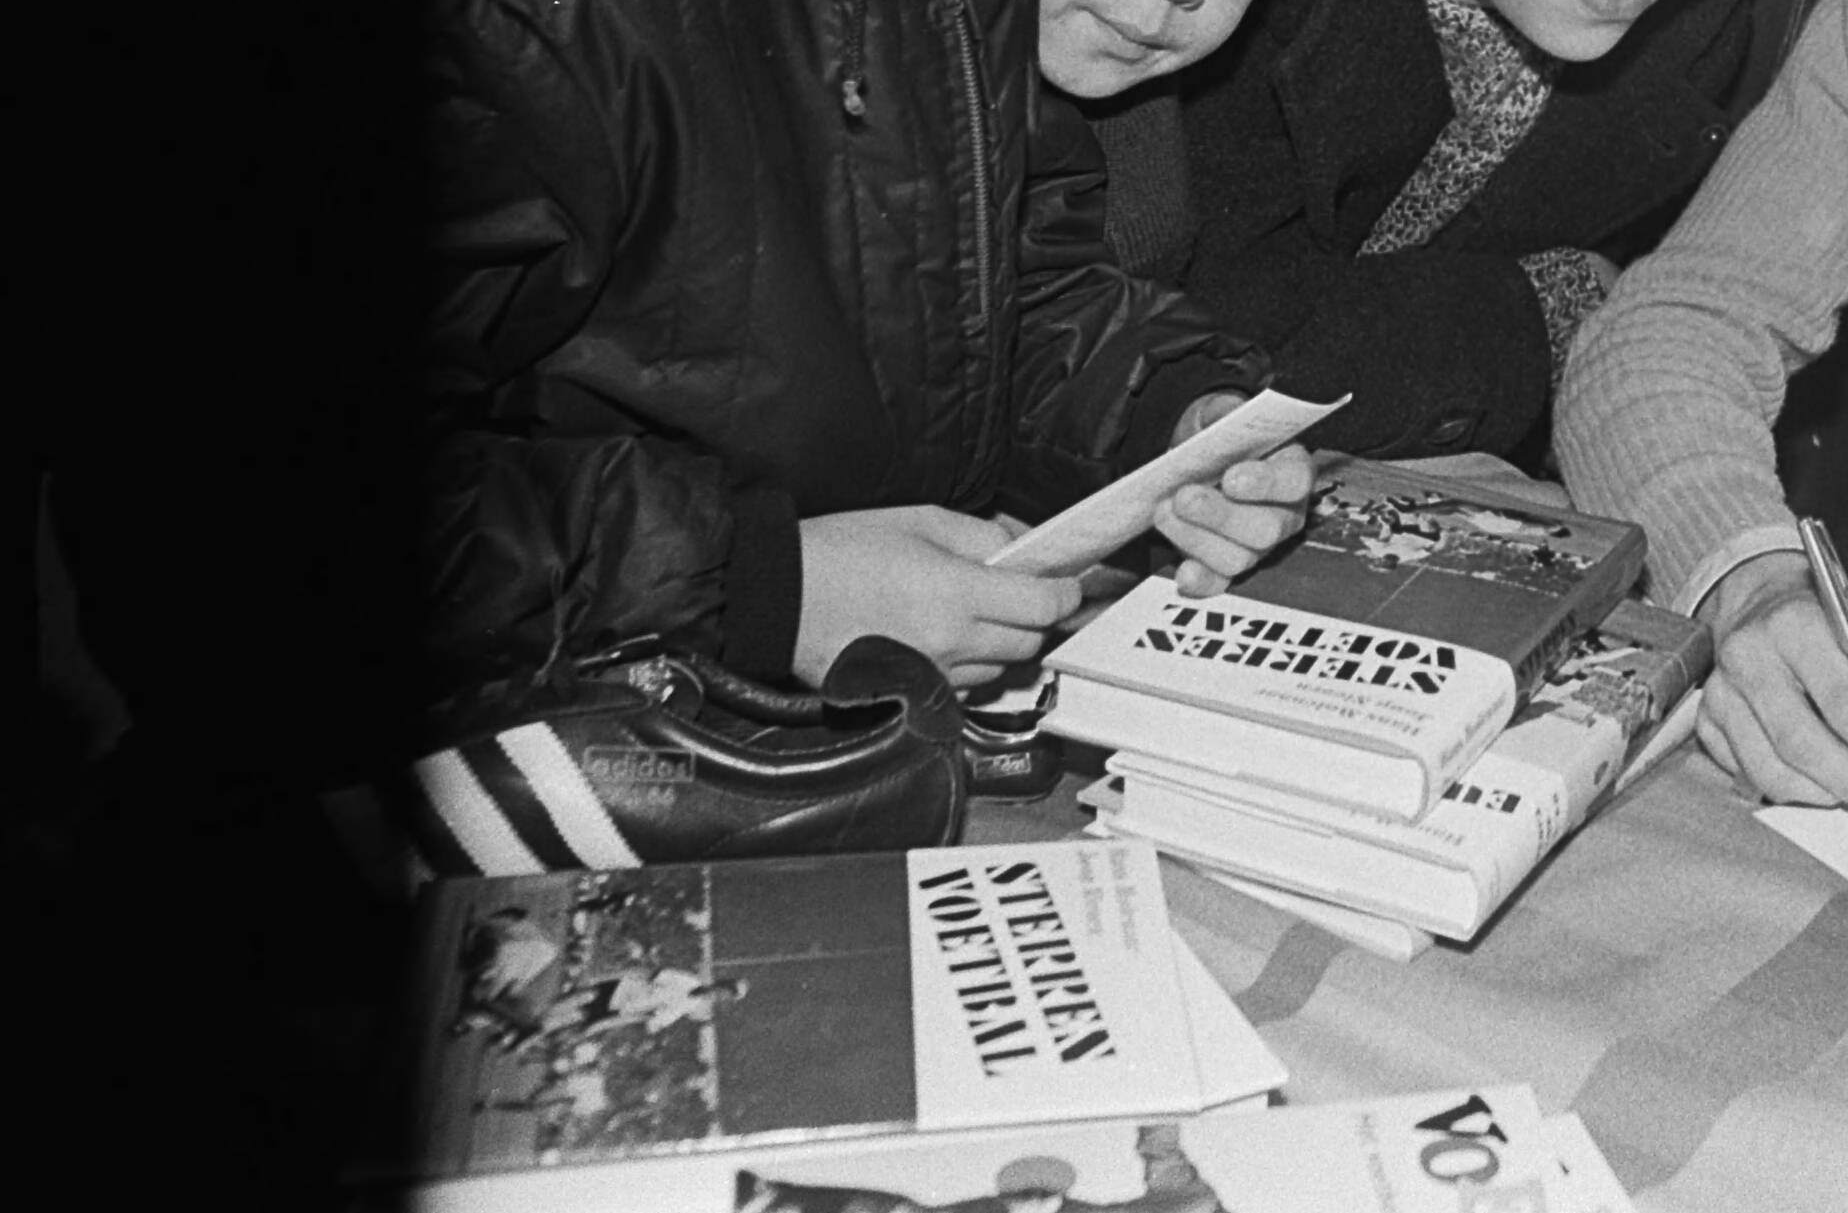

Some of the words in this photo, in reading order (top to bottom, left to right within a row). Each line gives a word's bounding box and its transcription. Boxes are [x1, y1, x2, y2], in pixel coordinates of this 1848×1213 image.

[1132, 627, 1449, 695] STERREN
[1158, 603, 1457, 671] VOETBAL
[917, 865, 1038, 1078] VOETBAL
[986, 862, 1116, 1067] STERREN
